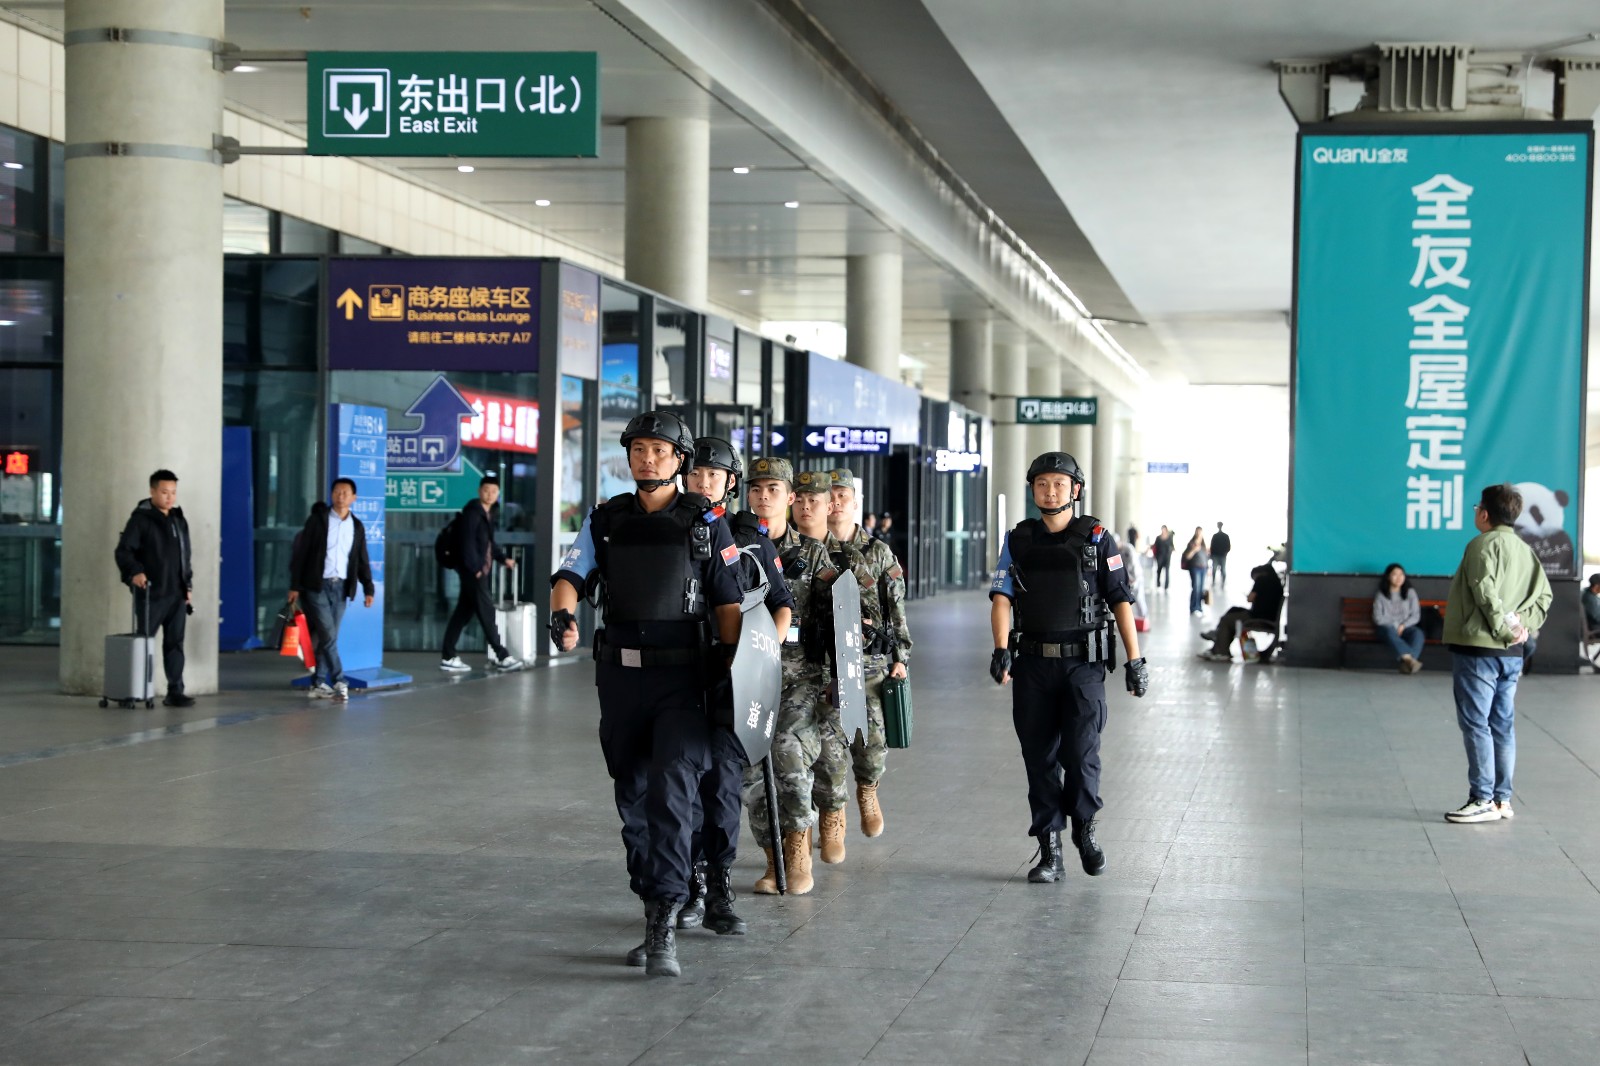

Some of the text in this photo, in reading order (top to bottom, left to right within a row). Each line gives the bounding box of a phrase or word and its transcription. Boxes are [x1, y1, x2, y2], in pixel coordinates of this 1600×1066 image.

[398, 73, 582, 115] 东出口(北)
[400, 116, 478, 133] East Exit
[408, 286, 531, 308] 商务座候车区
[407, 310, 531, 324] Business Class Lounge
[1405, 173, 1474, 530] 全友全屋定制
[387, 436, 417, 454] 站口
[0, 452, 28, 474] 店
[853, 623, 862, 689] POLICE
